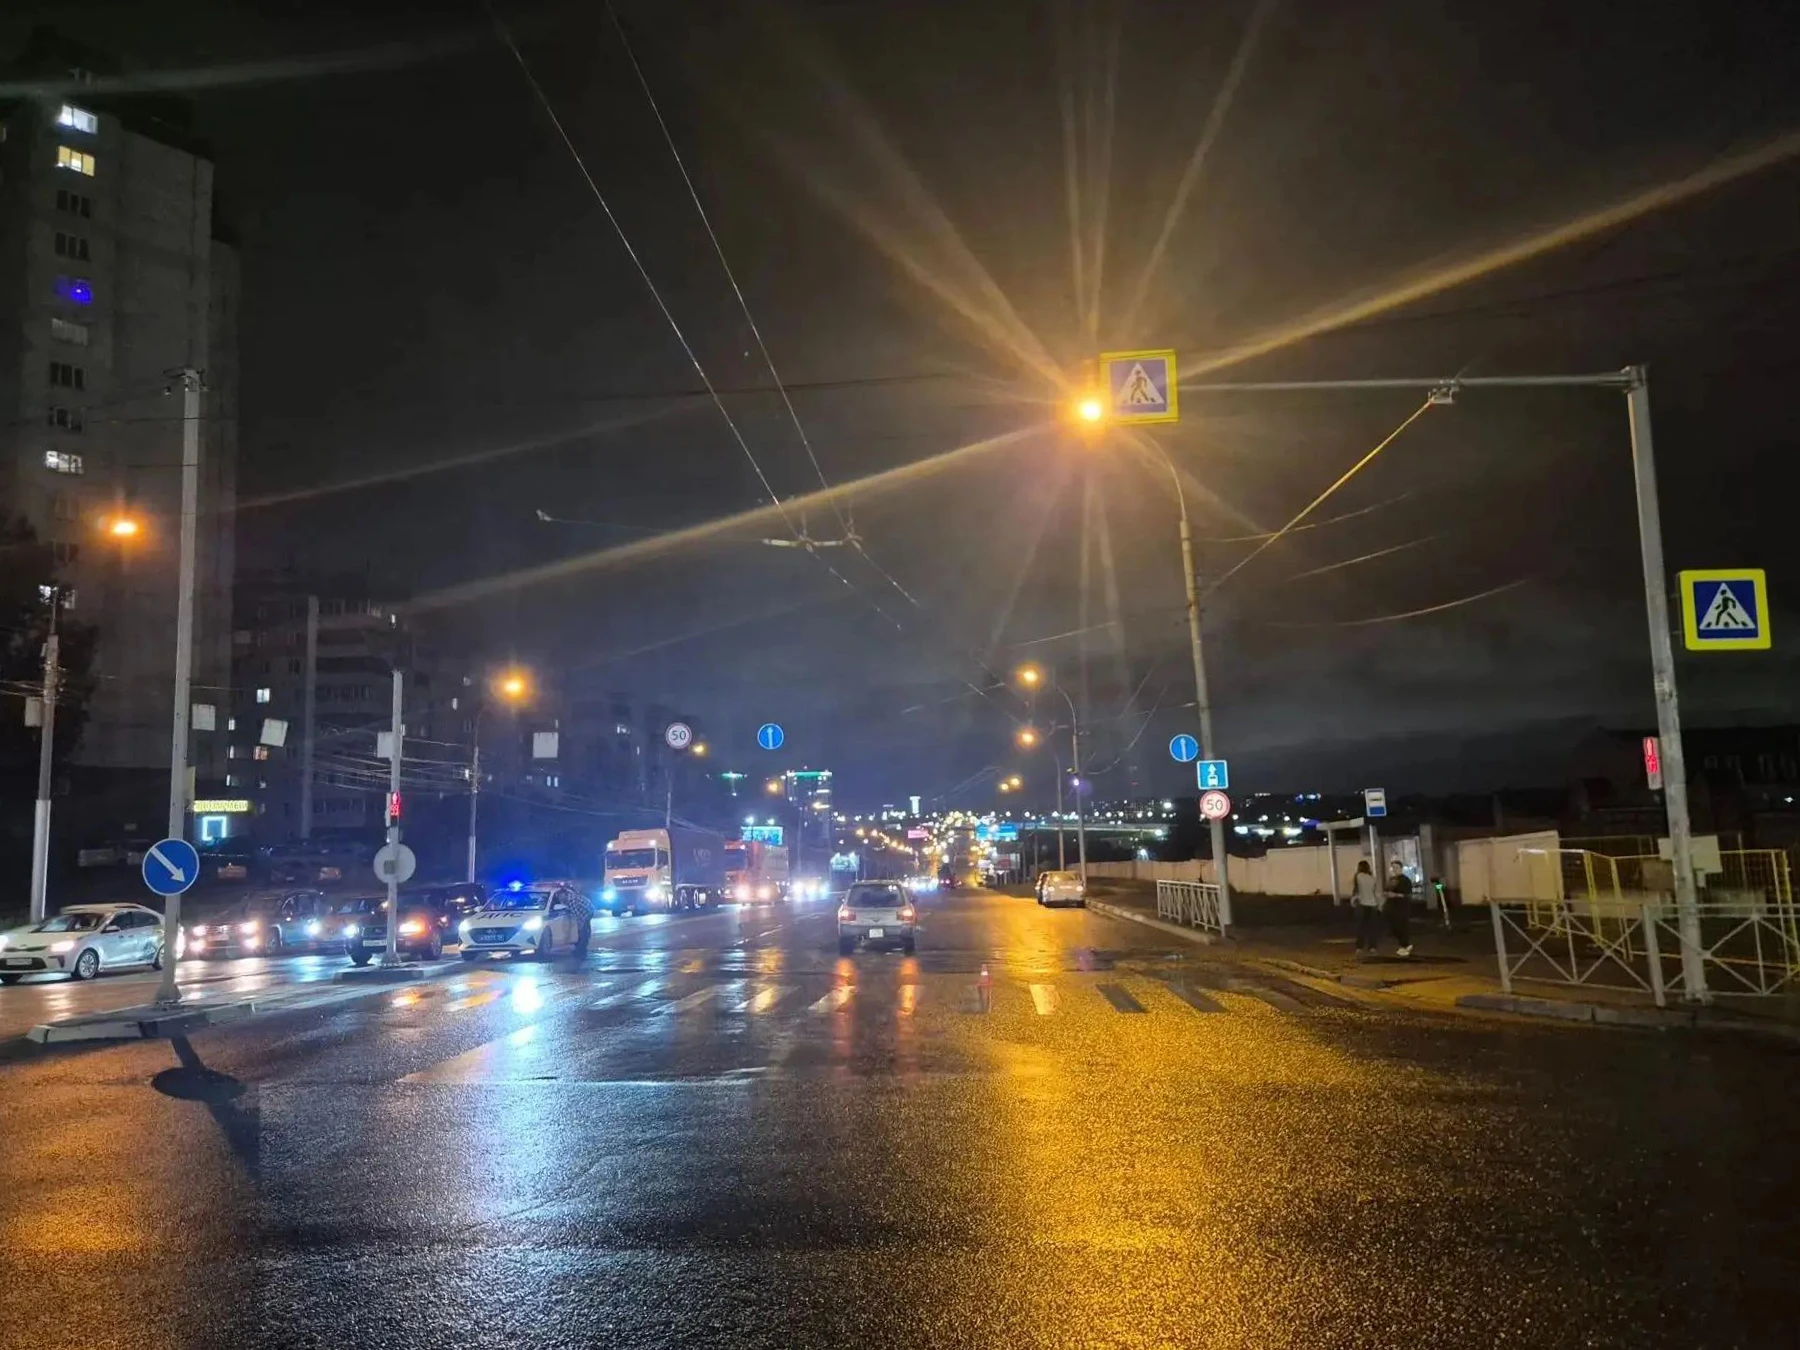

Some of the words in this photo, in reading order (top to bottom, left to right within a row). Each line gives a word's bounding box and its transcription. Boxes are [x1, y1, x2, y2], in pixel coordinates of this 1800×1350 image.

[670, 730, 687, 741] 50
[1206, 799, 1223, 811] 50
[477, 912, 523, 920] ДПС
